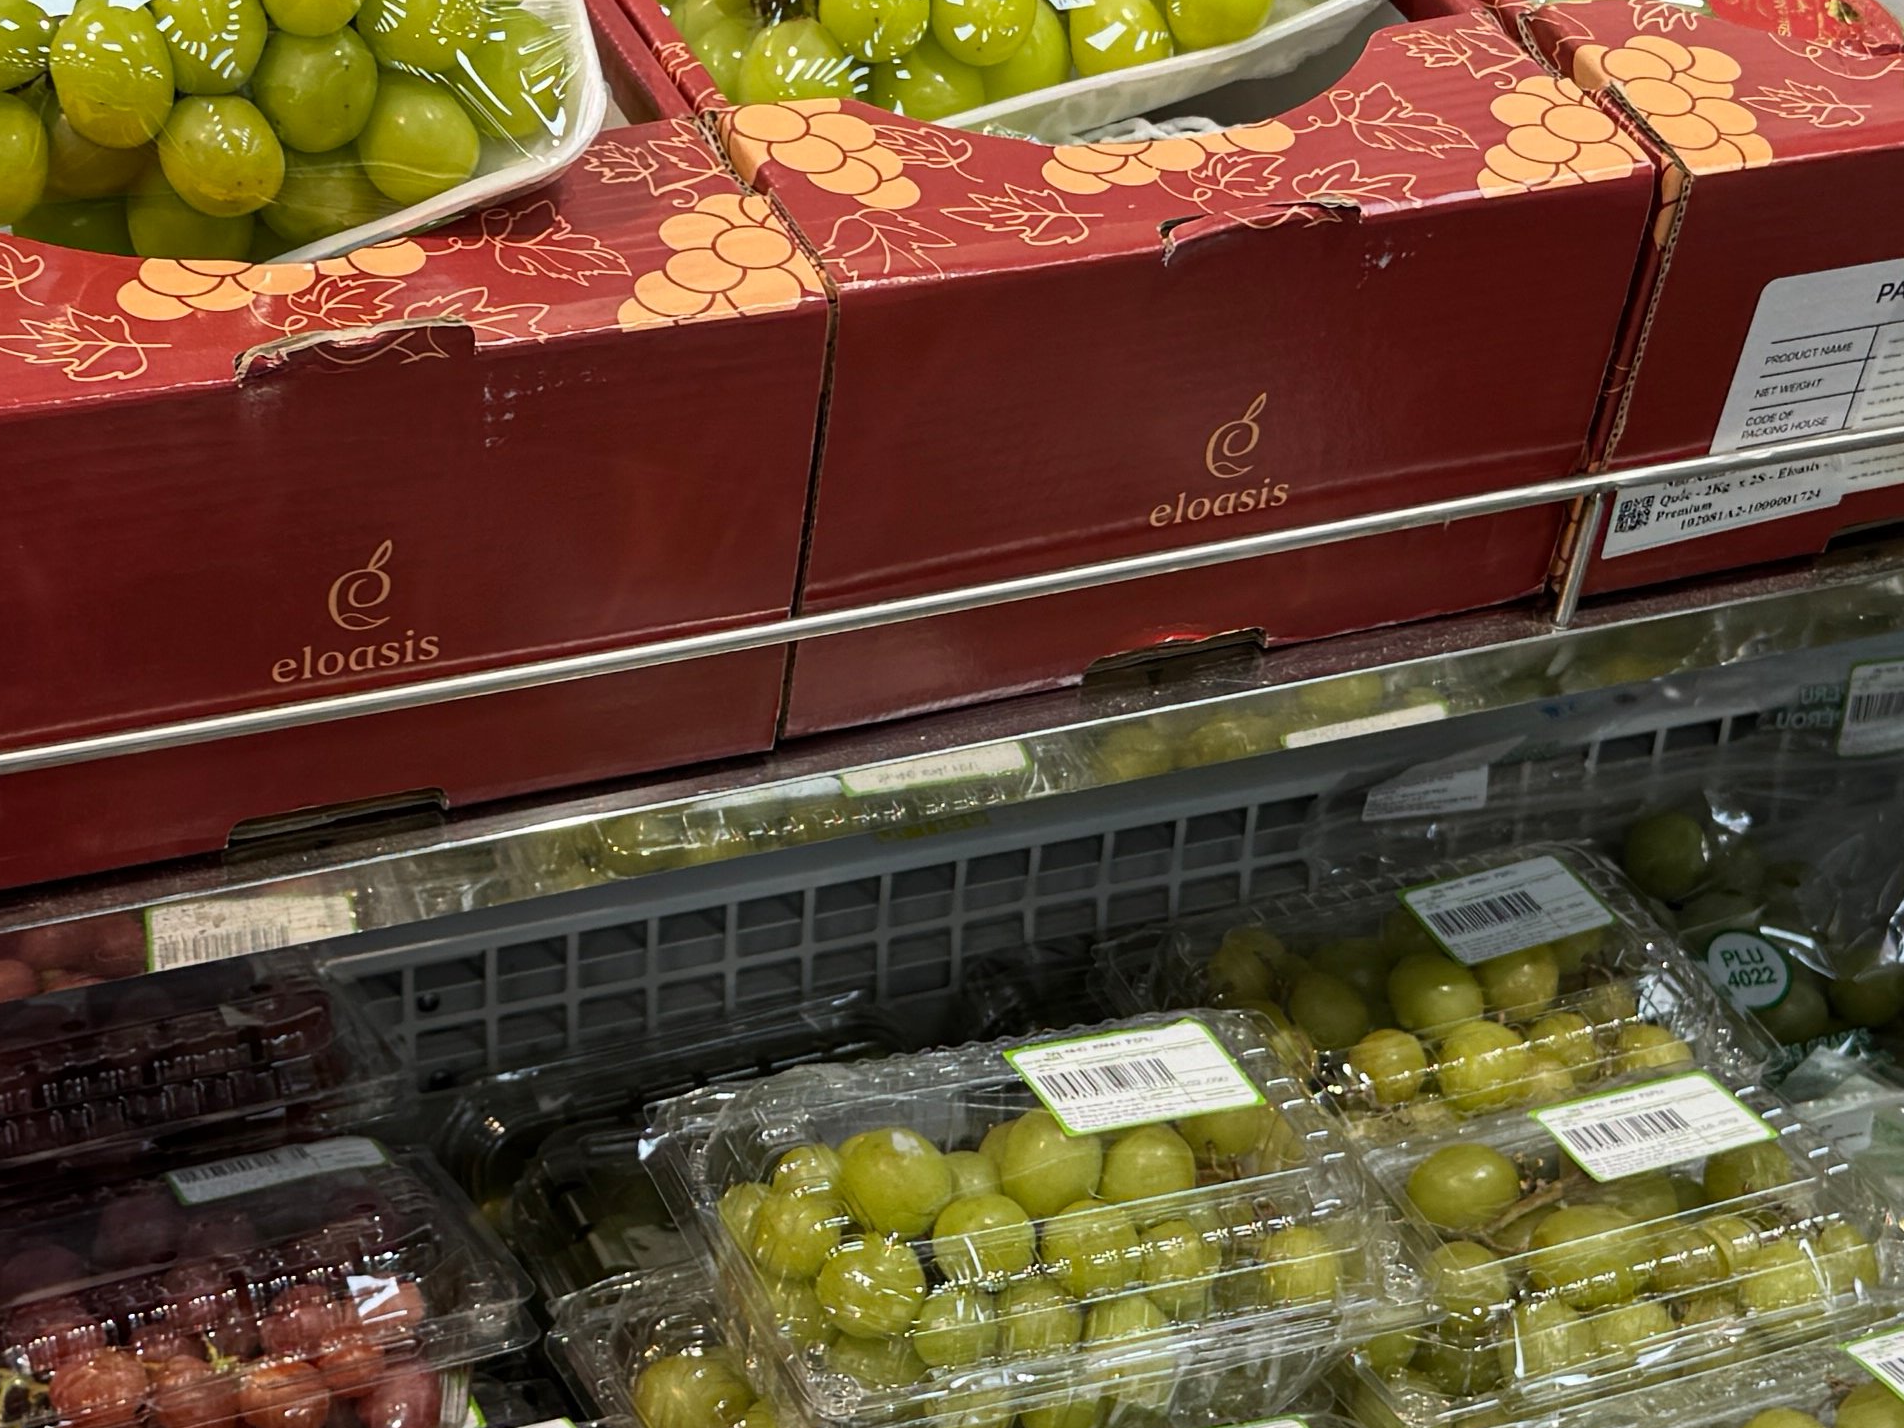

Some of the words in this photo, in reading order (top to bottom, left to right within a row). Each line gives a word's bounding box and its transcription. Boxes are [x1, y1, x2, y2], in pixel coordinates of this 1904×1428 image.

[1765, 348, 1819, 365] PRODUCT
[1821, 342, 1853, 355] NAME
[1755, 386, 1778, 398] NET
[1780, 378, 1823, 393] WEIGHT
[1745, 413, 1776, 427] CODE
[1790, 417, 1829, 431] HOUSE
[1149, 476, 1290, 529] eloasis
[1655, 502, 1713, 522] Premium
[271, 631, 440, 685] eloasis
[1720, 947, 1765, 968] PLU
[1728, 966, 1777, 988] 4022
